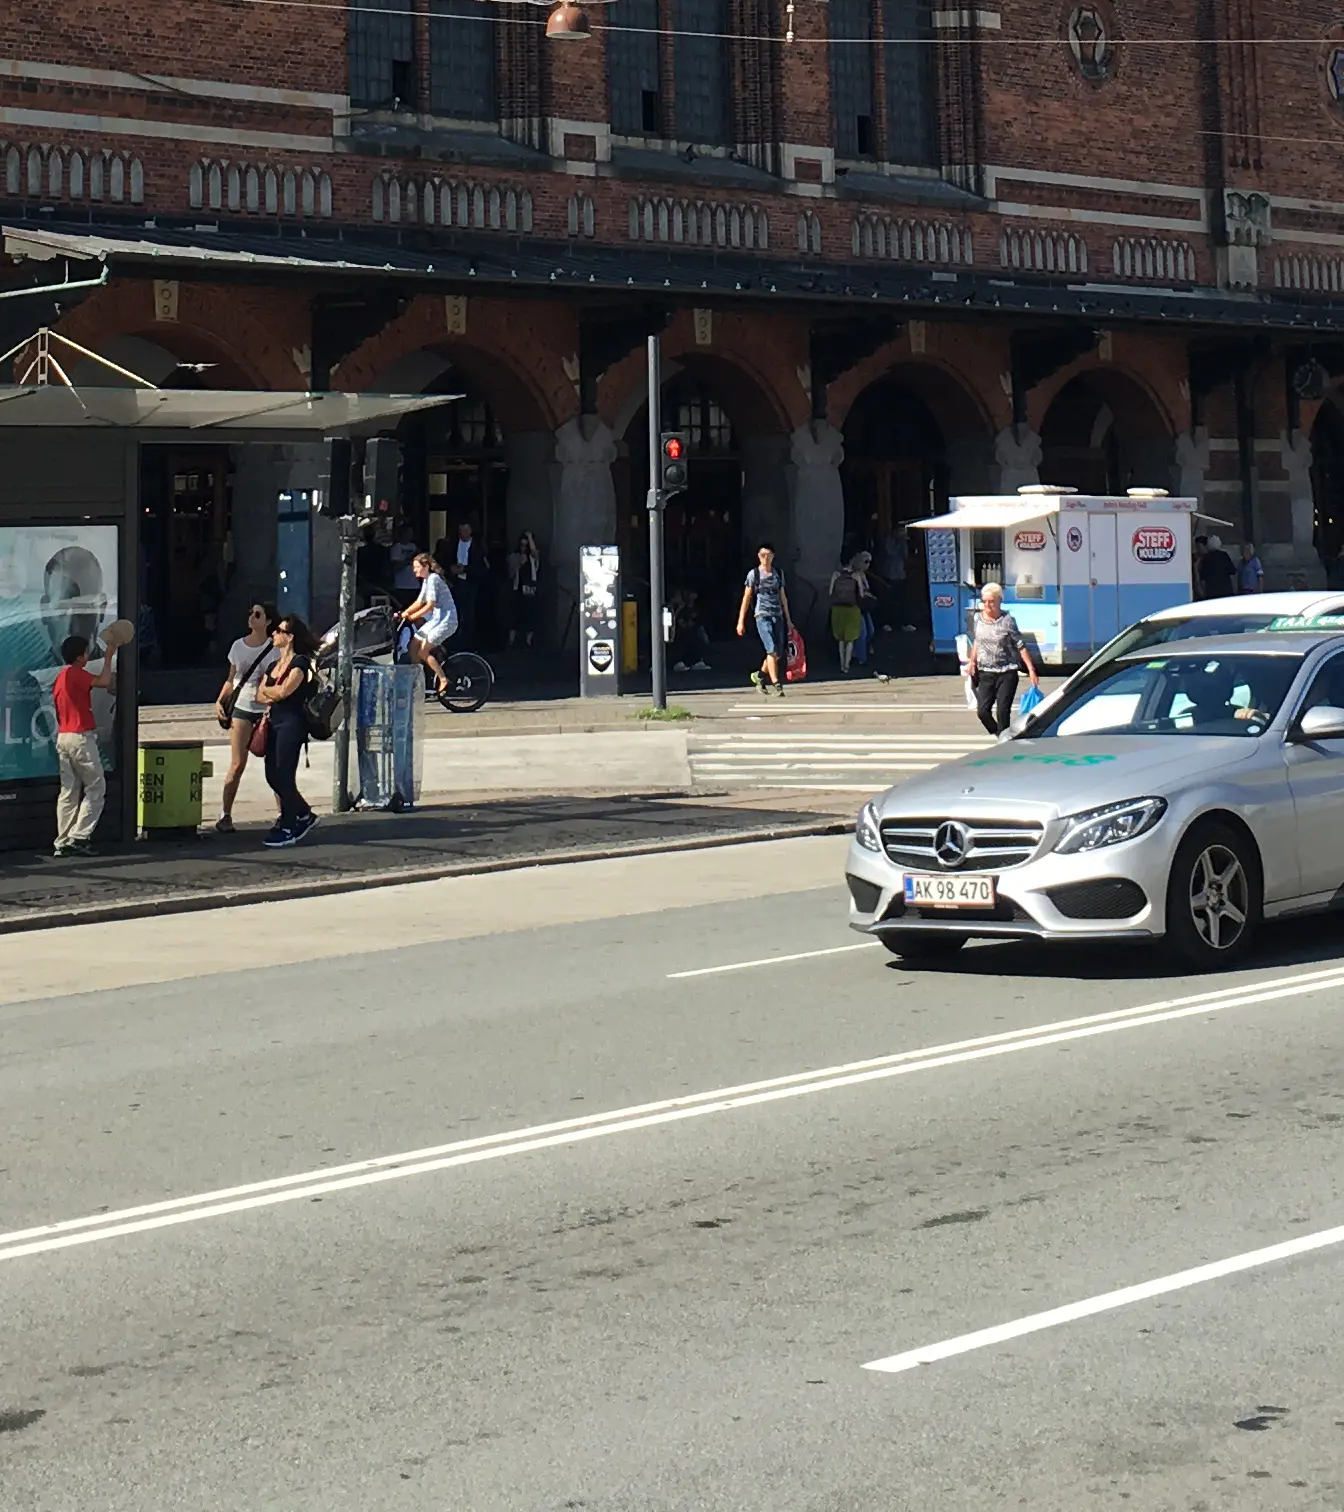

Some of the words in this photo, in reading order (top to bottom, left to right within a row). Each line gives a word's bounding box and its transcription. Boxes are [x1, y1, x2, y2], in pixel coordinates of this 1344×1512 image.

[1017, 533, 1042, 543] STEFF
[1136, 531, 1170, 548] STEFF
[1275, 616, 1314, 627] TAXI
[915, 881, 933, 899] AK
[937, 881, 955, 899] 98
[960, 881, 989, 899] 470
